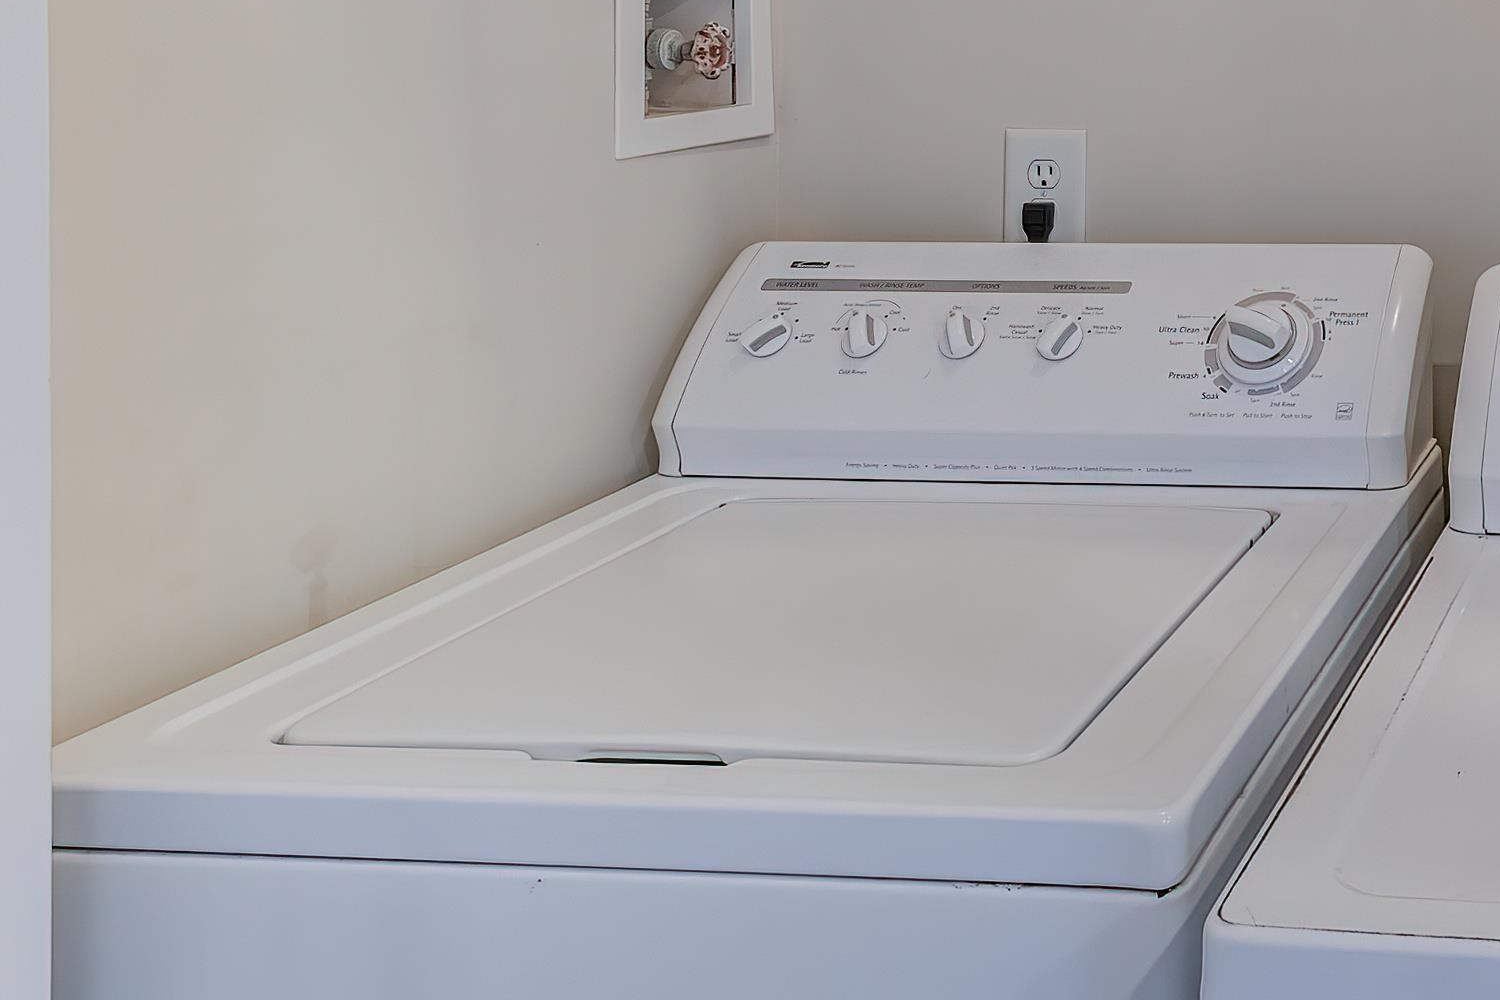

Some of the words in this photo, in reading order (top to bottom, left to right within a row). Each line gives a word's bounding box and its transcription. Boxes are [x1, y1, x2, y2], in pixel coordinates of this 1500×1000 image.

[1329, 311, 1368, 319] Permanent
[1168, 371, 1199, 379] Prewash
[1201, 392, 1219, 400] Soak
